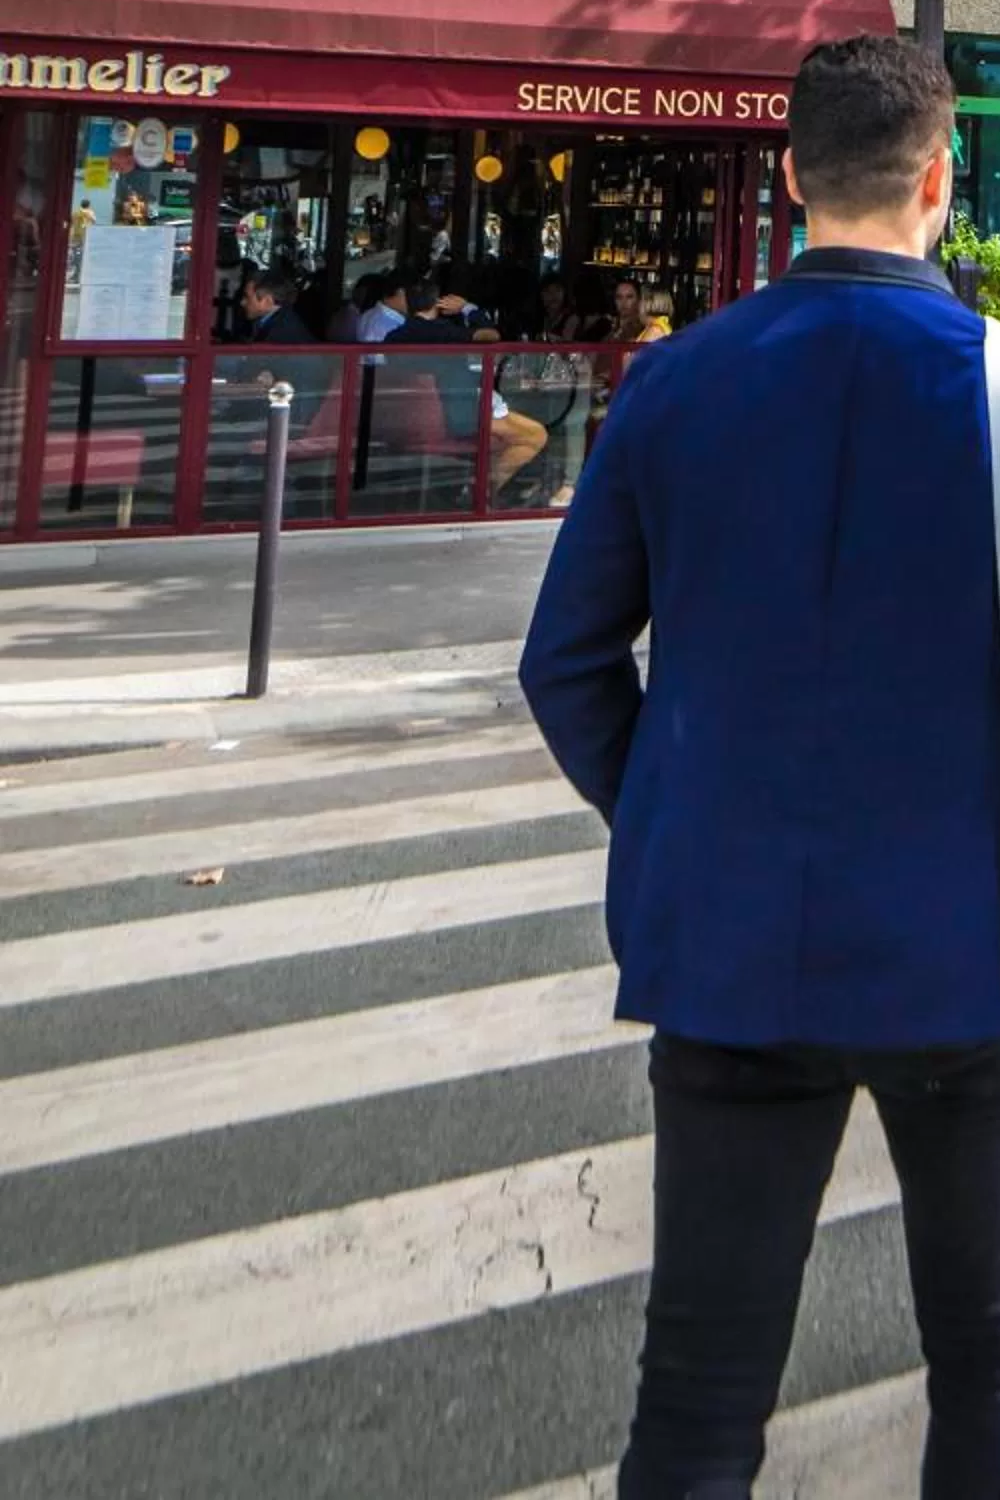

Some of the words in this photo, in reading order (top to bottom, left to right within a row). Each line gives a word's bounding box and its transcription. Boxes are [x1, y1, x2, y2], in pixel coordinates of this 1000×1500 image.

[517, 83, 641, 115] SERVICE
[654, 89, 723, 117] NON
[734, 92, 790, 120] STO
